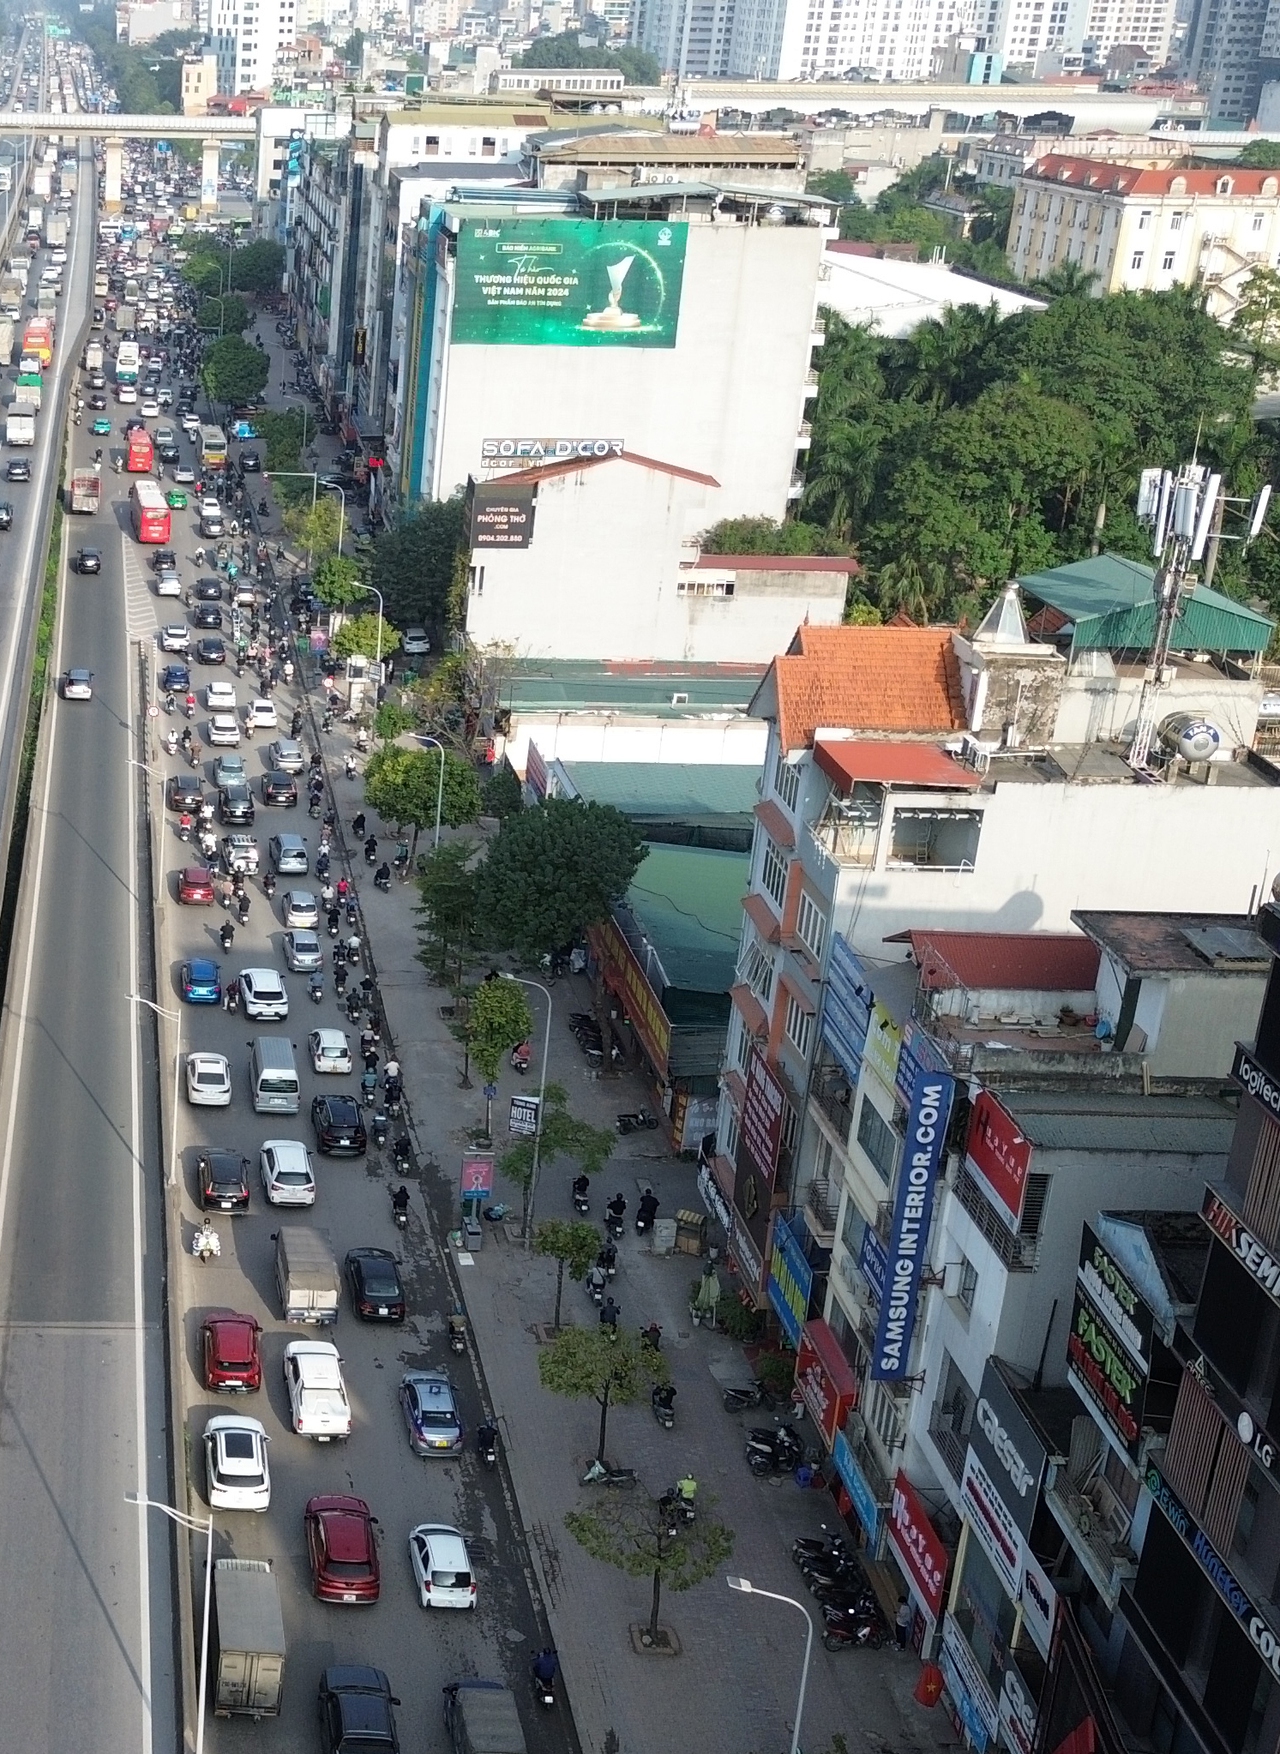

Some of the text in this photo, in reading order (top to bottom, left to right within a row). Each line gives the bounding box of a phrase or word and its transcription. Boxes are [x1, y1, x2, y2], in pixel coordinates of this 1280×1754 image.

[474, 274, 579, 286] THƯƠNG HIỆU QUỐC GIA
[482, 285, 569, 297] VIỆT NAM NĂM 2024
[483, 440, 545, 456] SOFA
[1238, 1055, 1280, 1112] logitec
[511, 1106, 536, 1123] HOTEL
[897, 1084, 943, 1255] INTERIOR.COM
[1093, 1245, 1138, 1315] FASTER
[881, 1259, 915, 1372] SAMSUNG
[1078, 1307, 1137, 1405] FASTER
[1254, 1433, 1273, 1468] LG
